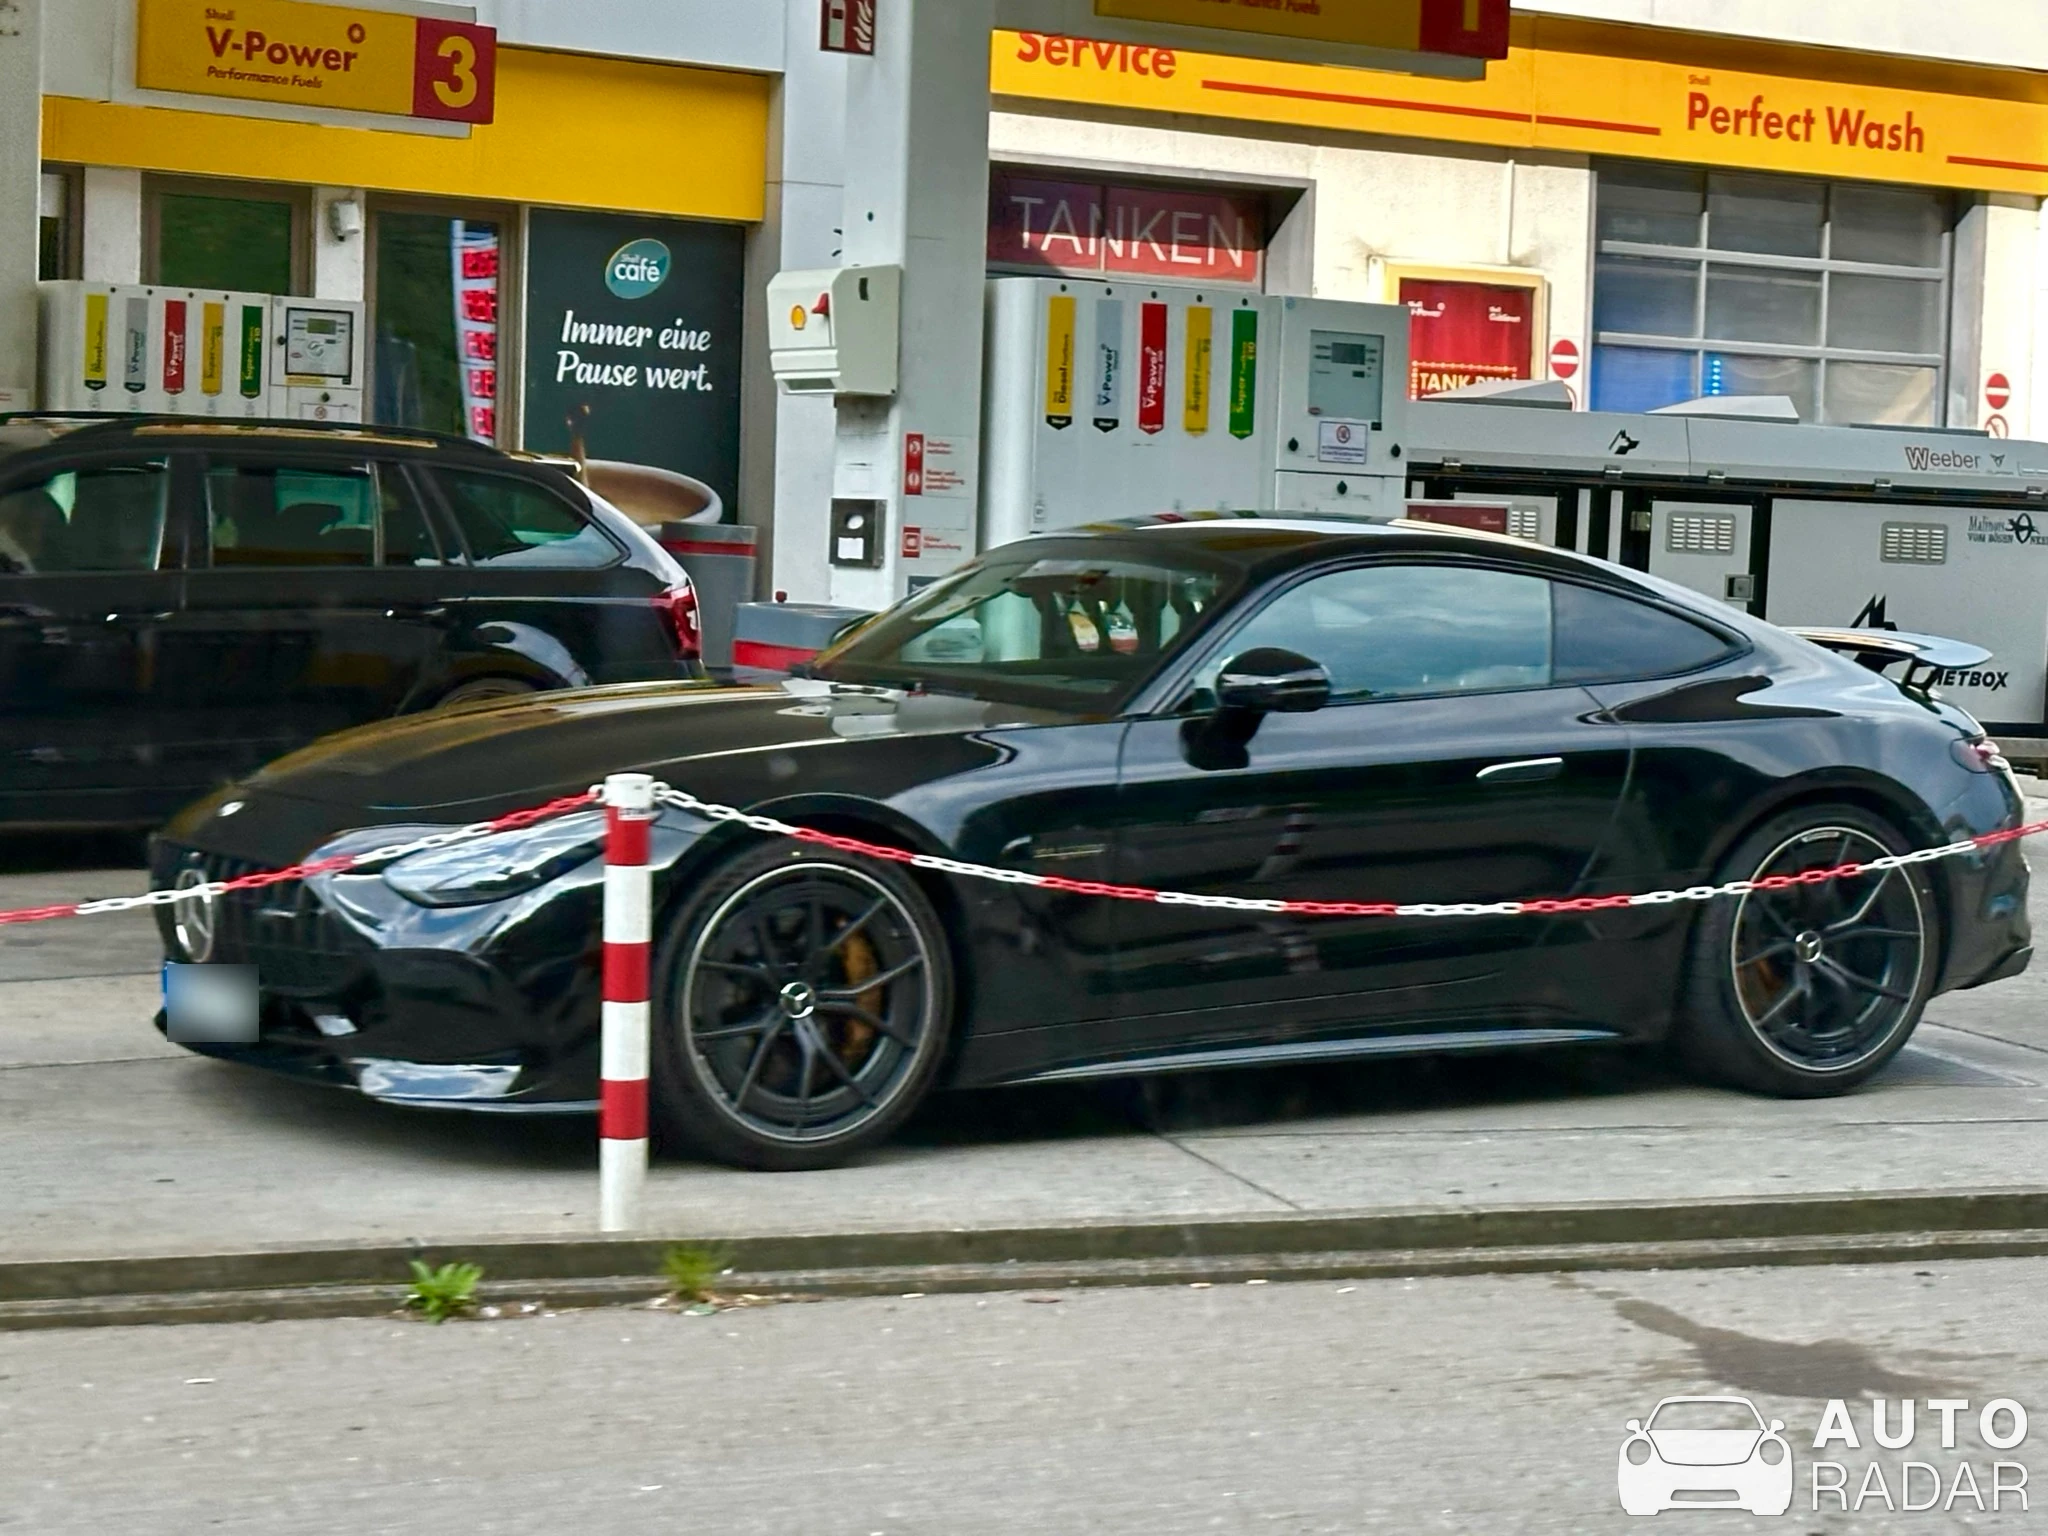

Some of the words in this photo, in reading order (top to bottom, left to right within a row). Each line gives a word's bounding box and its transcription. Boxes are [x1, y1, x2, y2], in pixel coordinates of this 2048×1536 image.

[206, 26, 358, 73] V-Power
[432, 36, 478, 108] 3
[1016, 31, 1177, 79] Service
[207, 65, 289, 85] Performance
[291, 75, 323, 89] Fuels
[1687, 92, 1815, 142] Perfect
[1826, 106, 1924, 153] Wash
[1010, 195, 1244, 268] TANKEN
[614, 257, 661, 282] café
[561, 309, 653, 348] Immer
[658, 317, 712, 352] eine
[555, 350, 638, 387] Pause
[645, 363, 714, 392] wert.
[1100, 347, 1114, 406] V-Power
[1143, 349, 1159, 408] V-Power
[1905, 446, 1981, 471] Weeber
